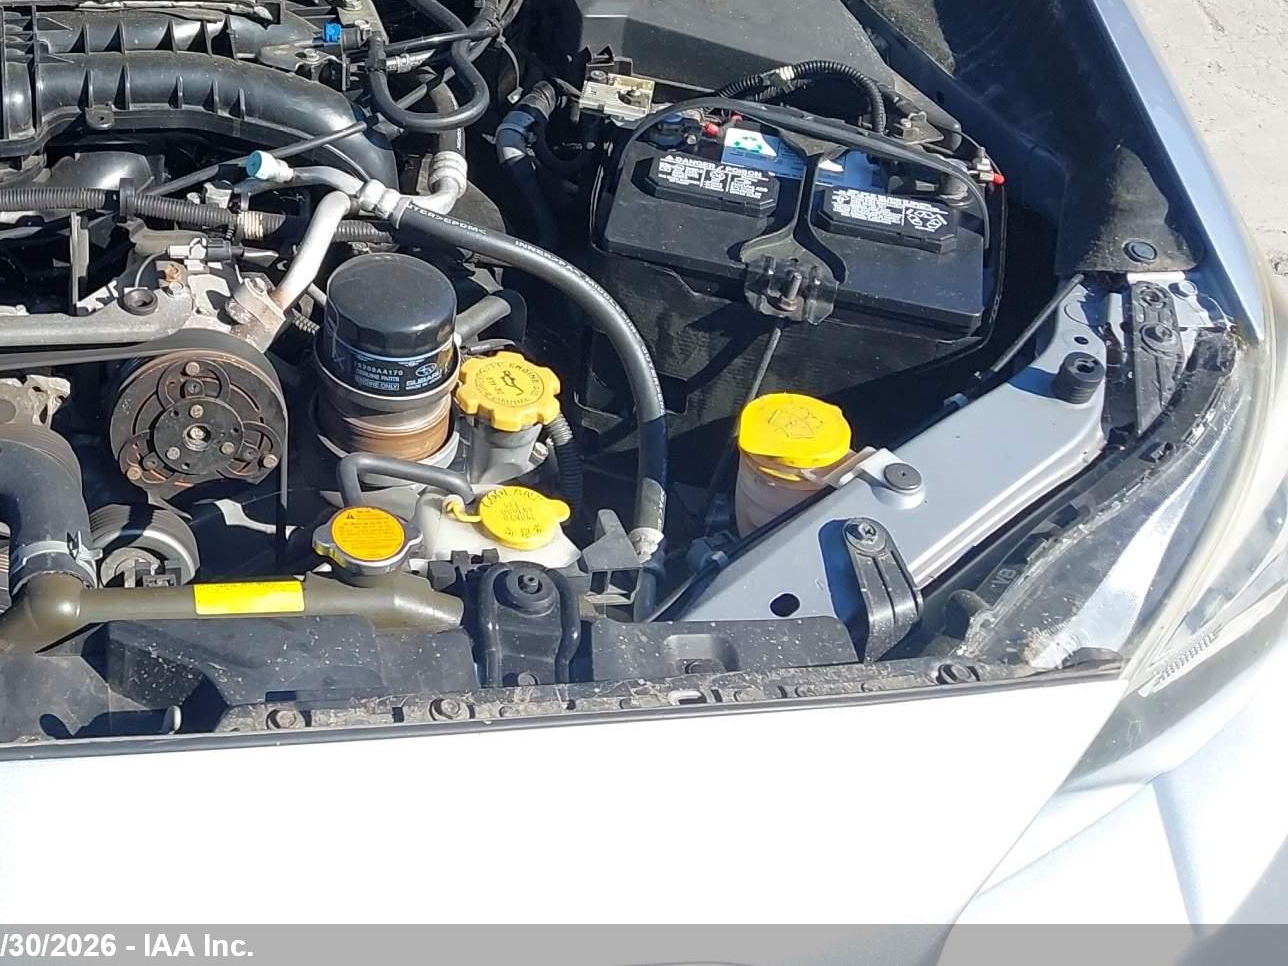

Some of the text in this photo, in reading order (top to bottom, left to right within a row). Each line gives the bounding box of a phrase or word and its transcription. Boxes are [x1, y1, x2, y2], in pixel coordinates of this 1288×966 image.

[674, 155, 716, 170] DANGER
[725, 166, 763, 179] POISON
[406, 368, 442, 386] SUBARU
